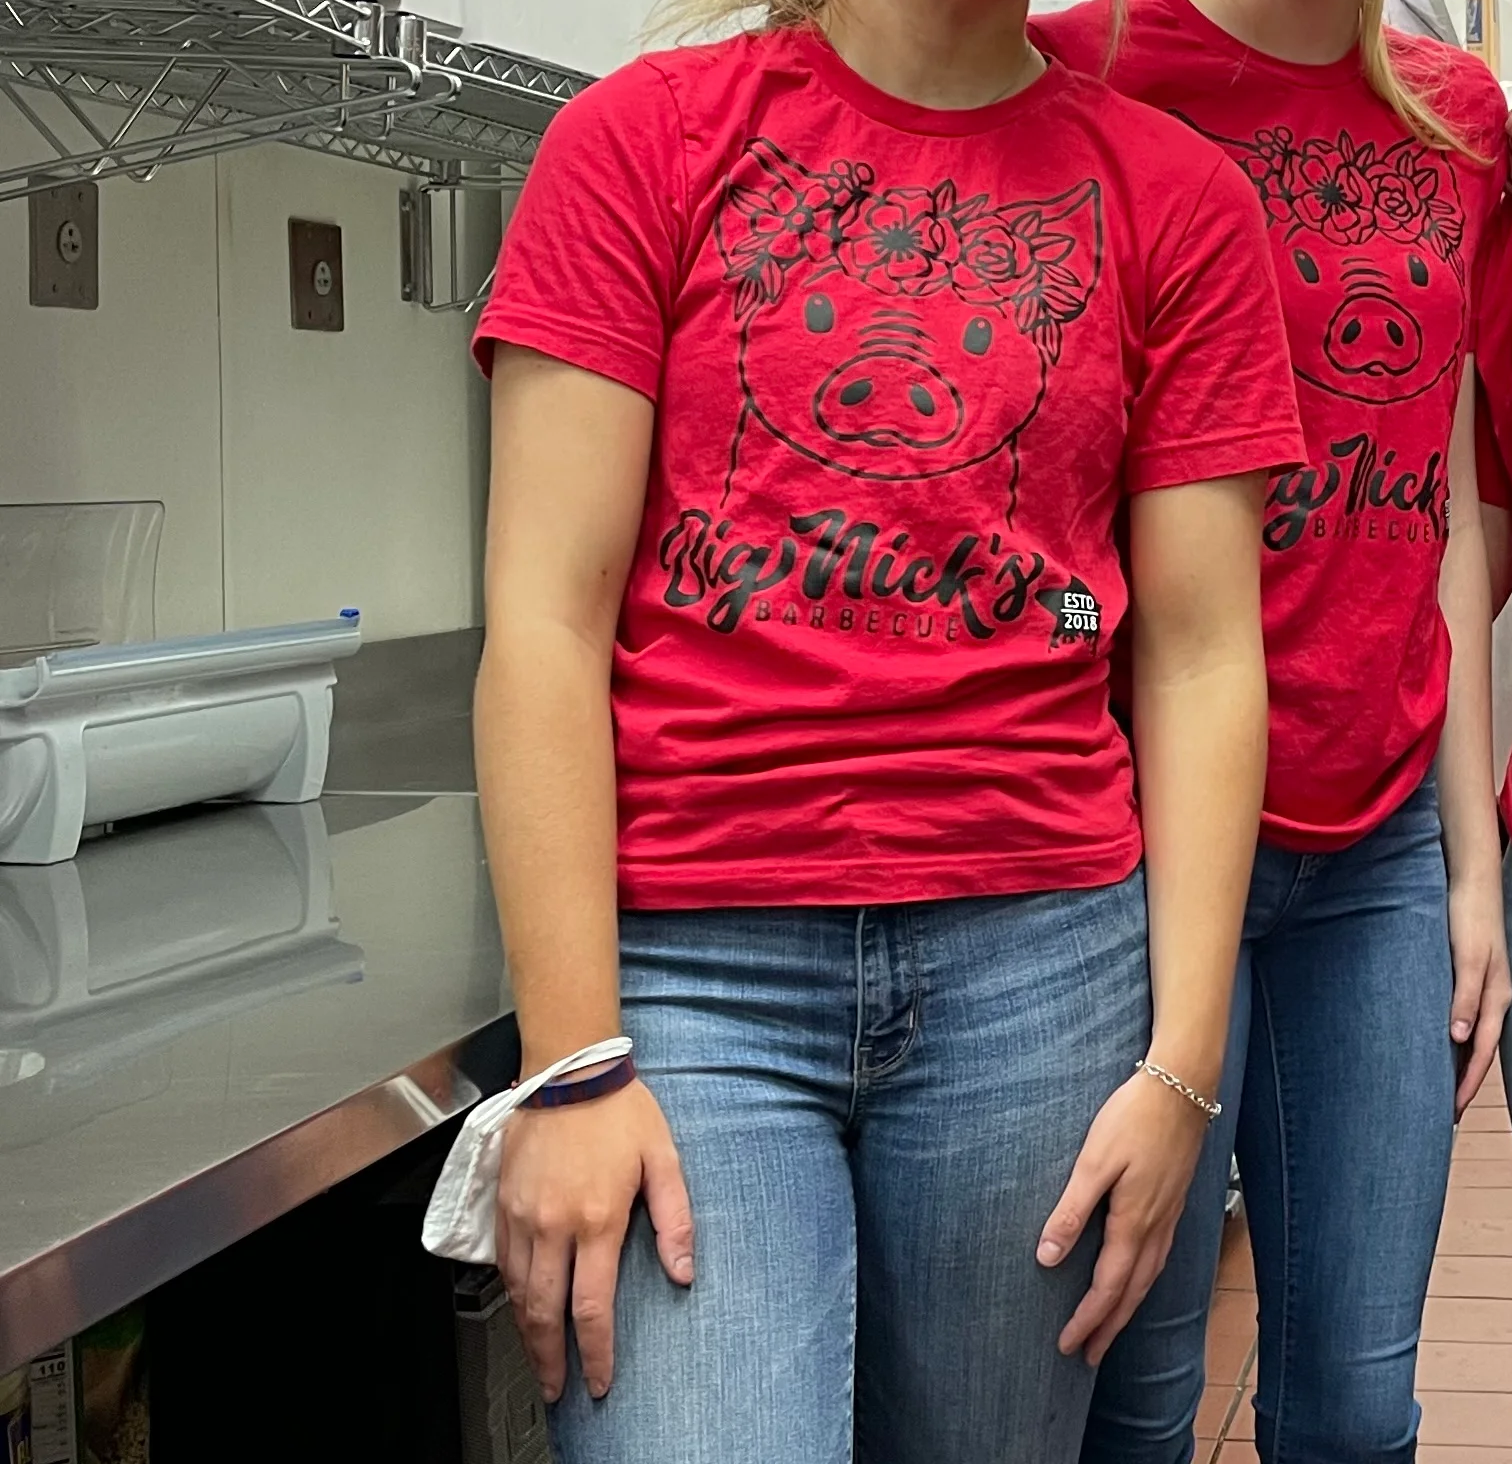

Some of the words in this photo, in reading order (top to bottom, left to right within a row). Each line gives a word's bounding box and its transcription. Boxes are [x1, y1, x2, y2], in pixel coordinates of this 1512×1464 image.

[789, 509, 1045, 639] Nick's
[1064, 592, 1095, 610] ESTD
[755, 600, 959, 642] BARBECUE
[1064, 613, 1098, 632] 2018
[39, 1360, 66, 1375] 110
